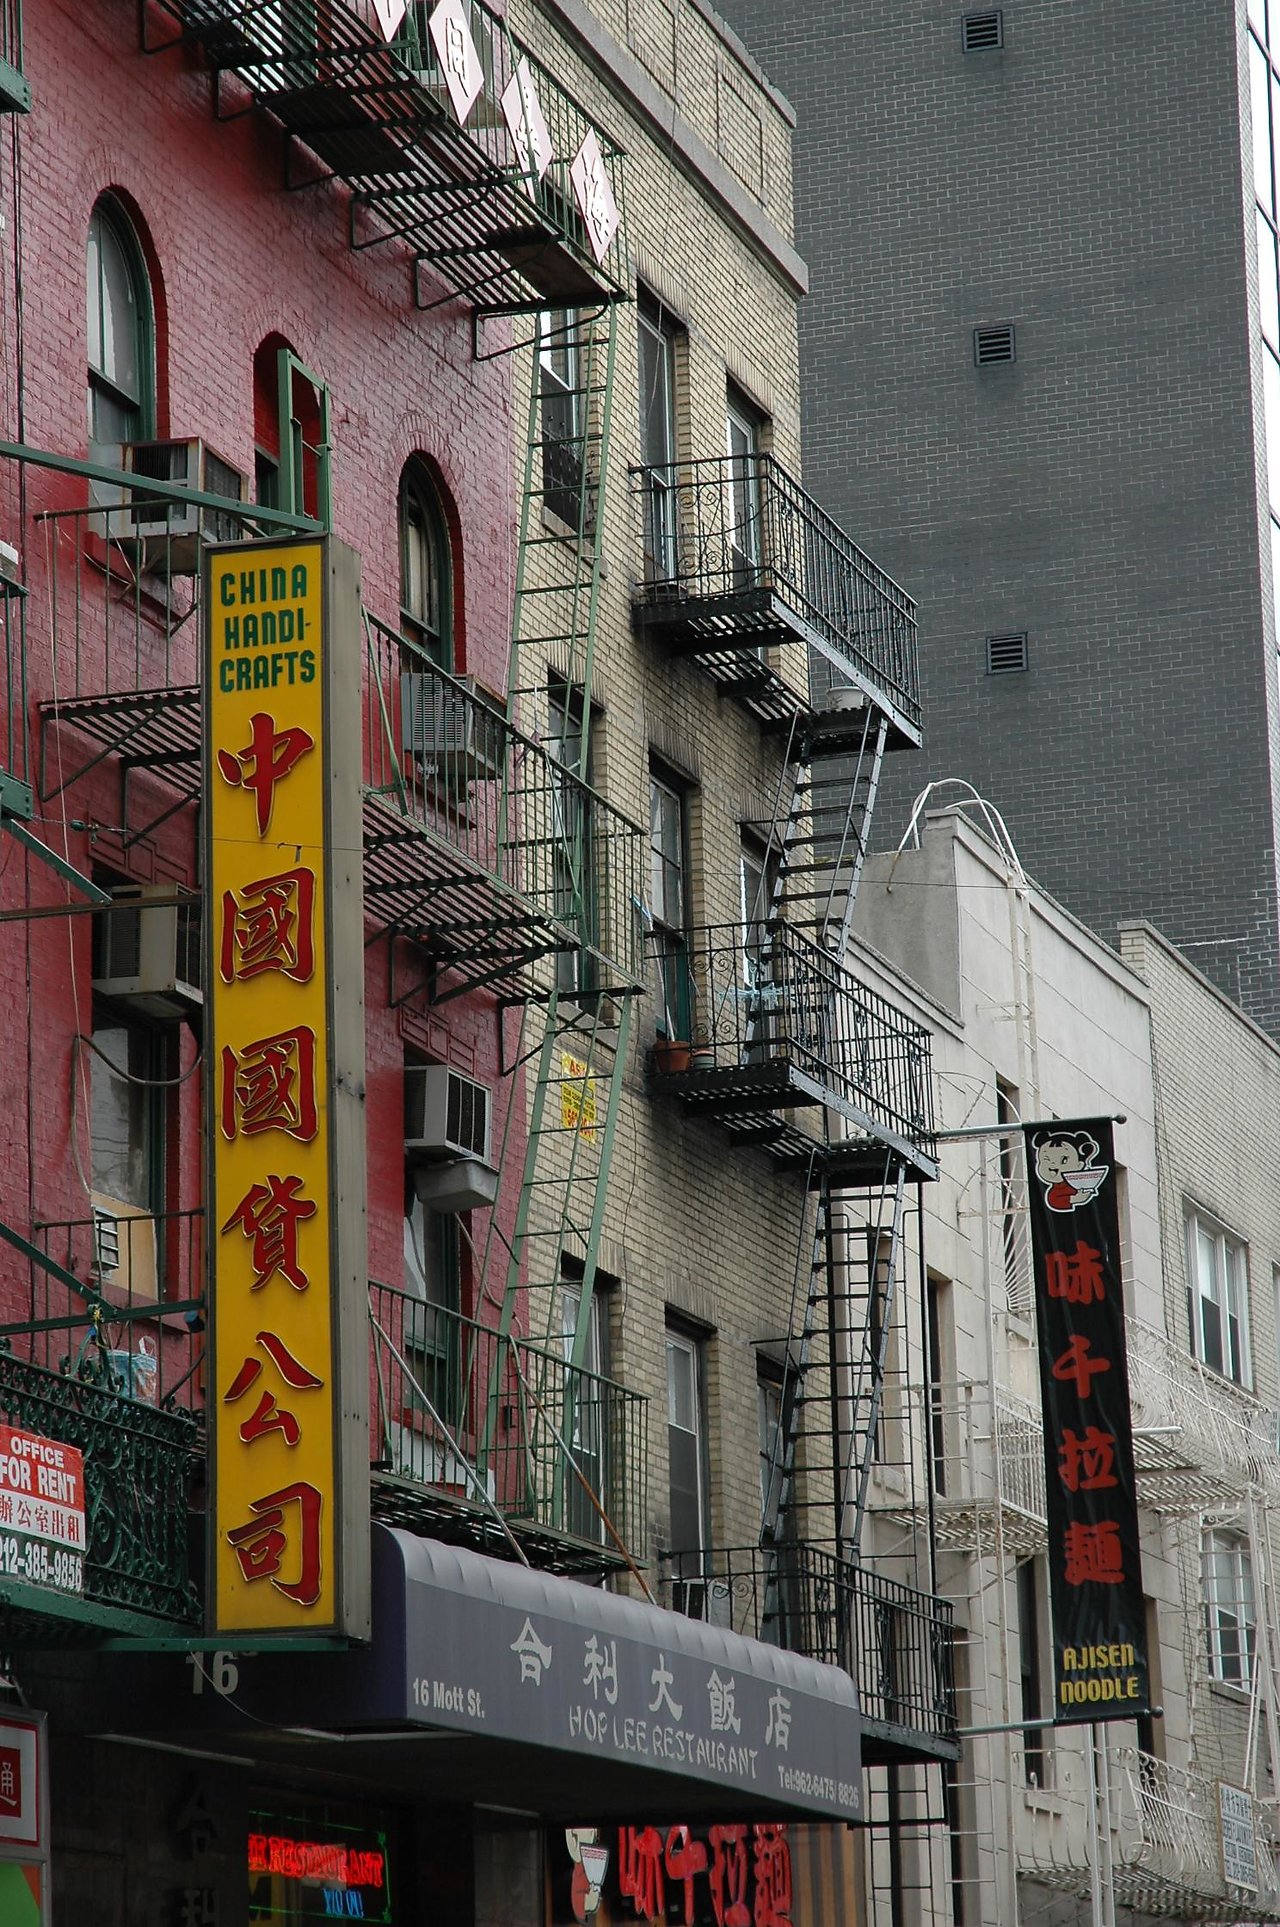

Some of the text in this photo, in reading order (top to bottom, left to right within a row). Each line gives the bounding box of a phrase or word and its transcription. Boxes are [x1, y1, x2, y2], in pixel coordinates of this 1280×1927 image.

[220, 564, 308, 607] CHINA
[224, 607, 311, 650] HANDI-
[219, 650, 316, 693] CRAFTS
[216, 711, 324, 1607] 中國國貨公司
[10, 1436, 64, 1468] OFFICE
[0, 1454, 76, 1504] FOR RENT
[186, 1650, 238, 1695] 16
[1063, 1643, 1134, 1671] AJISEN
[413, 1678, 485, 1719] 16 Mott St.
[510, 1616, 792, 1751] 合利大飯店
[1060, 1676, 1139, 1704] NOODLE
[569, 1705, 758, 1779] HOP LEE RESTAURANT
